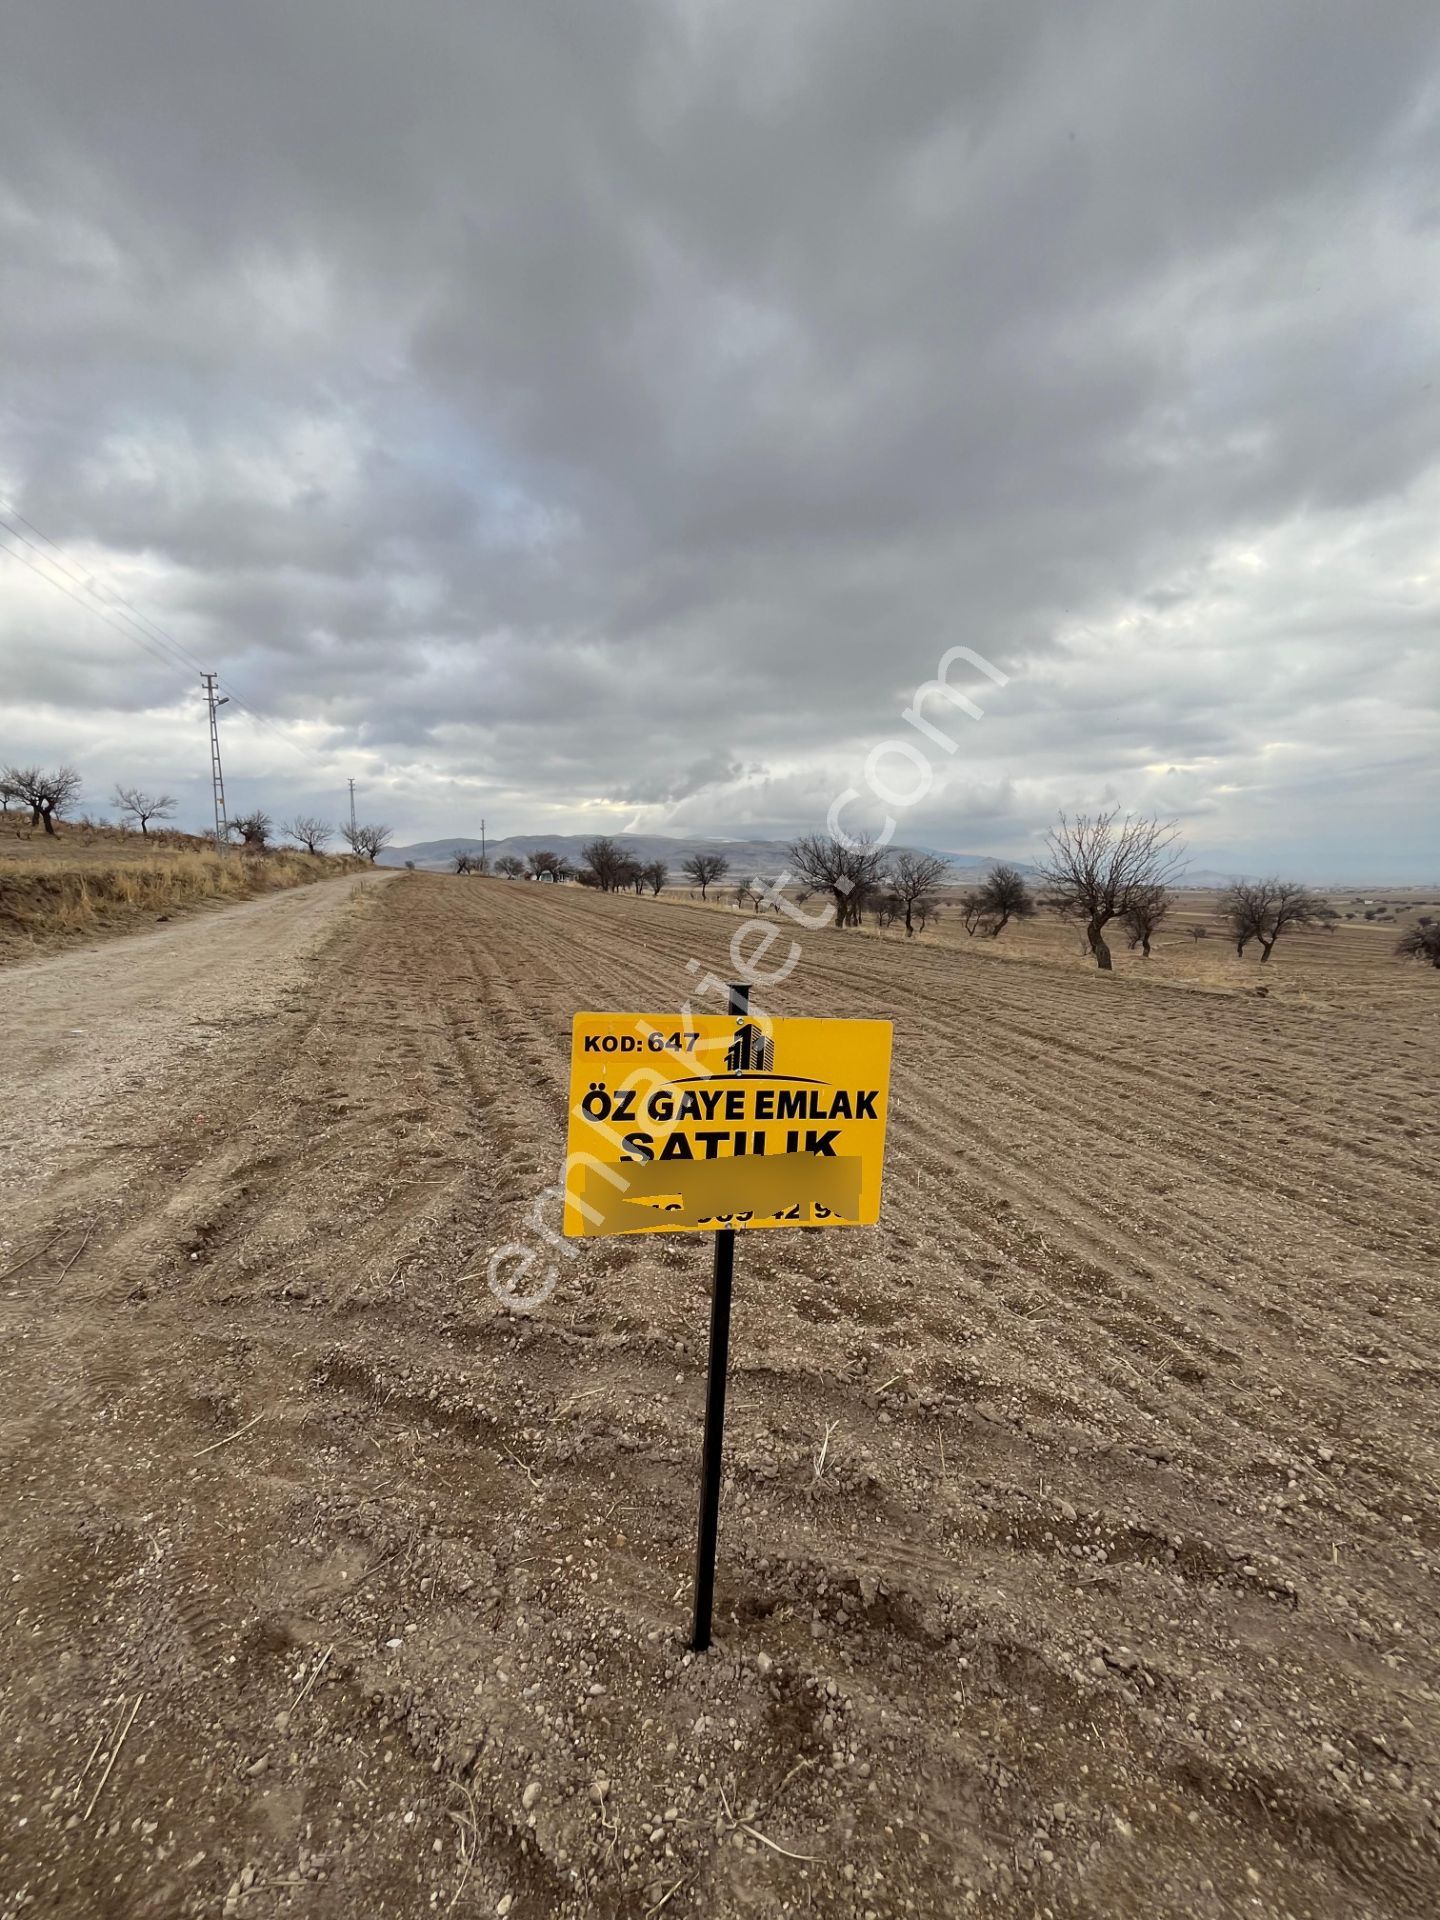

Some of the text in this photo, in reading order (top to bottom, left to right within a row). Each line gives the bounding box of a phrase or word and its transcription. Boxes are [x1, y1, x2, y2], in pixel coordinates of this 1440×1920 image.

[584, 1031, 700, 1053] KOD: 647
[581, 1082, 880, 1122] ÖZ GAYE EMLAK
